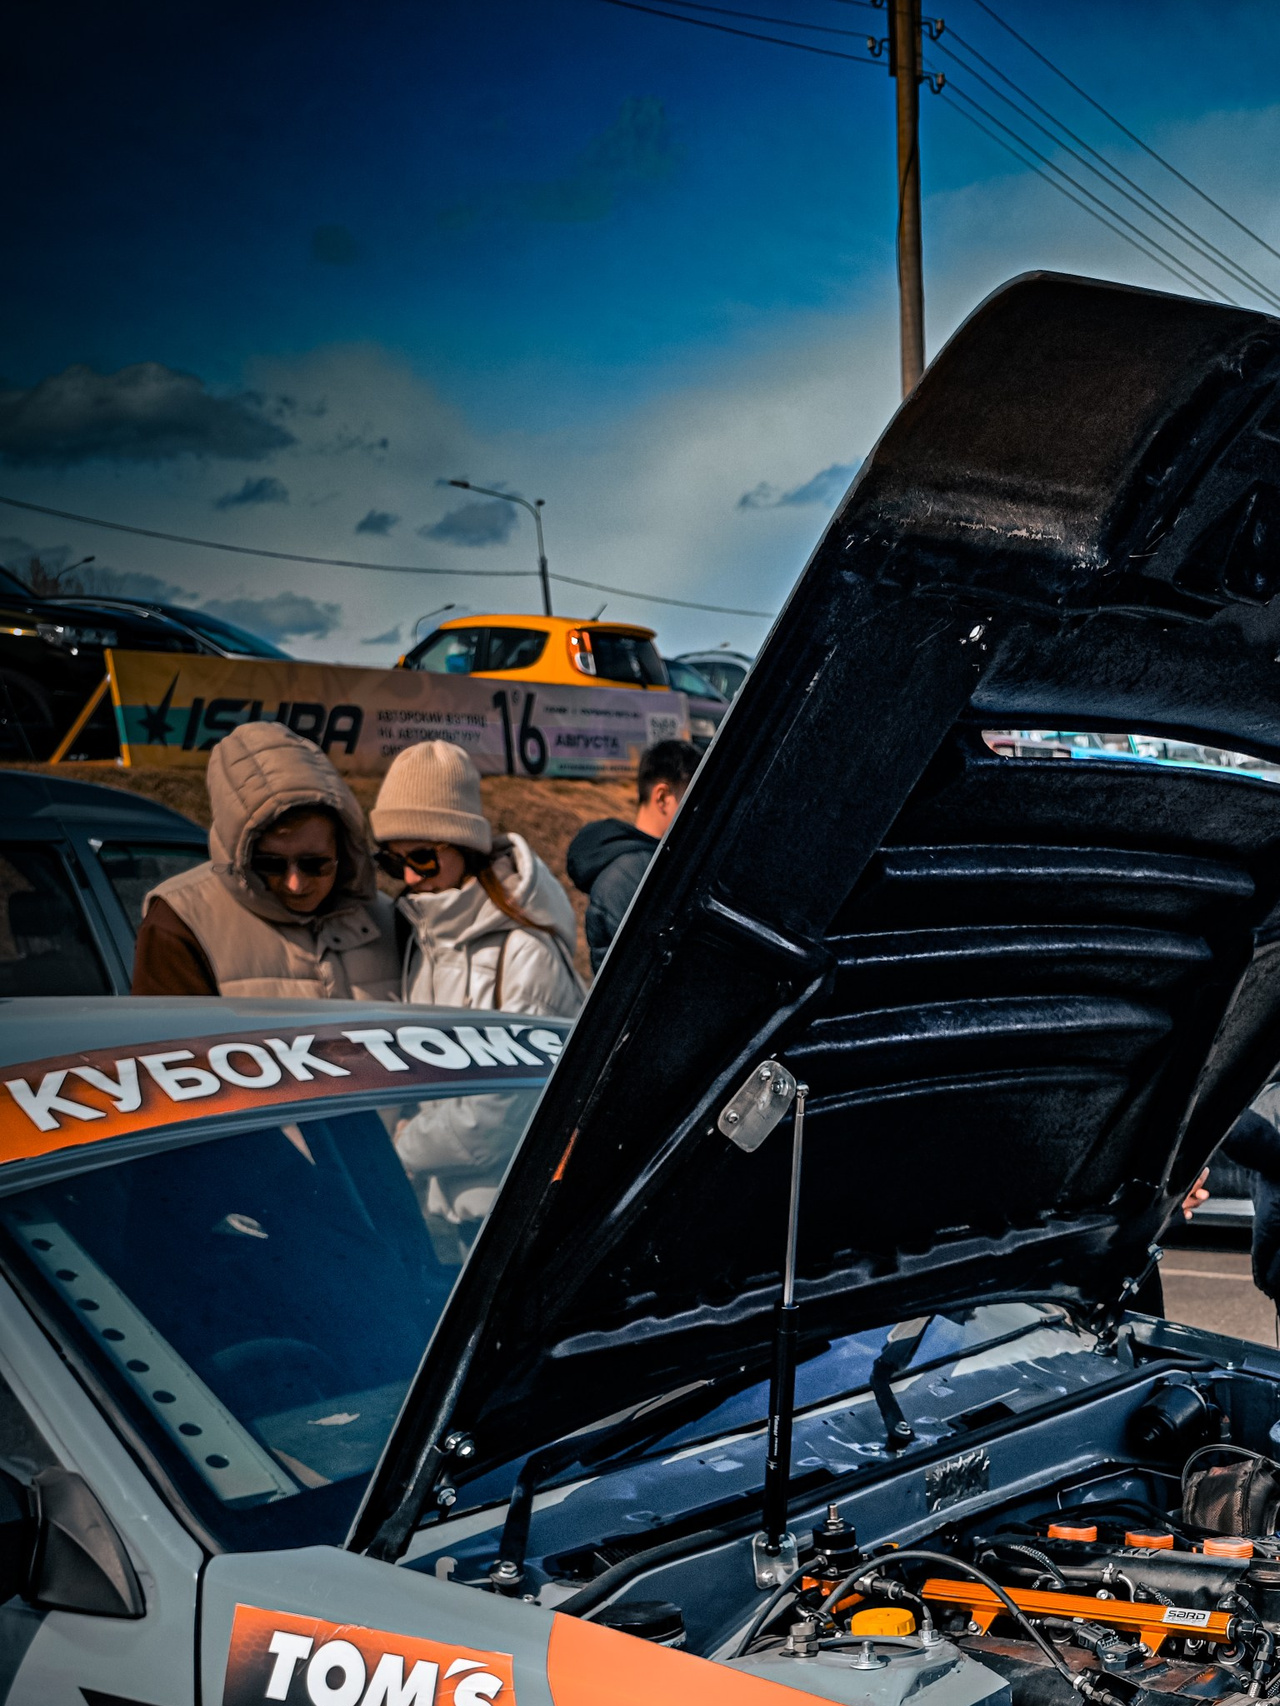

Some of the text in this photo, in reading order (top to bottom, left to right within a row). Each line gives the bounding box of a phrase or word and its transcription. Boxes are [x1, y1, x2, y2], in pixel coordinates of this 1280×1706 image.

[493, 690, 547, 775] 16
[554, 733, 621, 750] АВГУСТА
[5, 1033, 350, 1132] КУБОК
